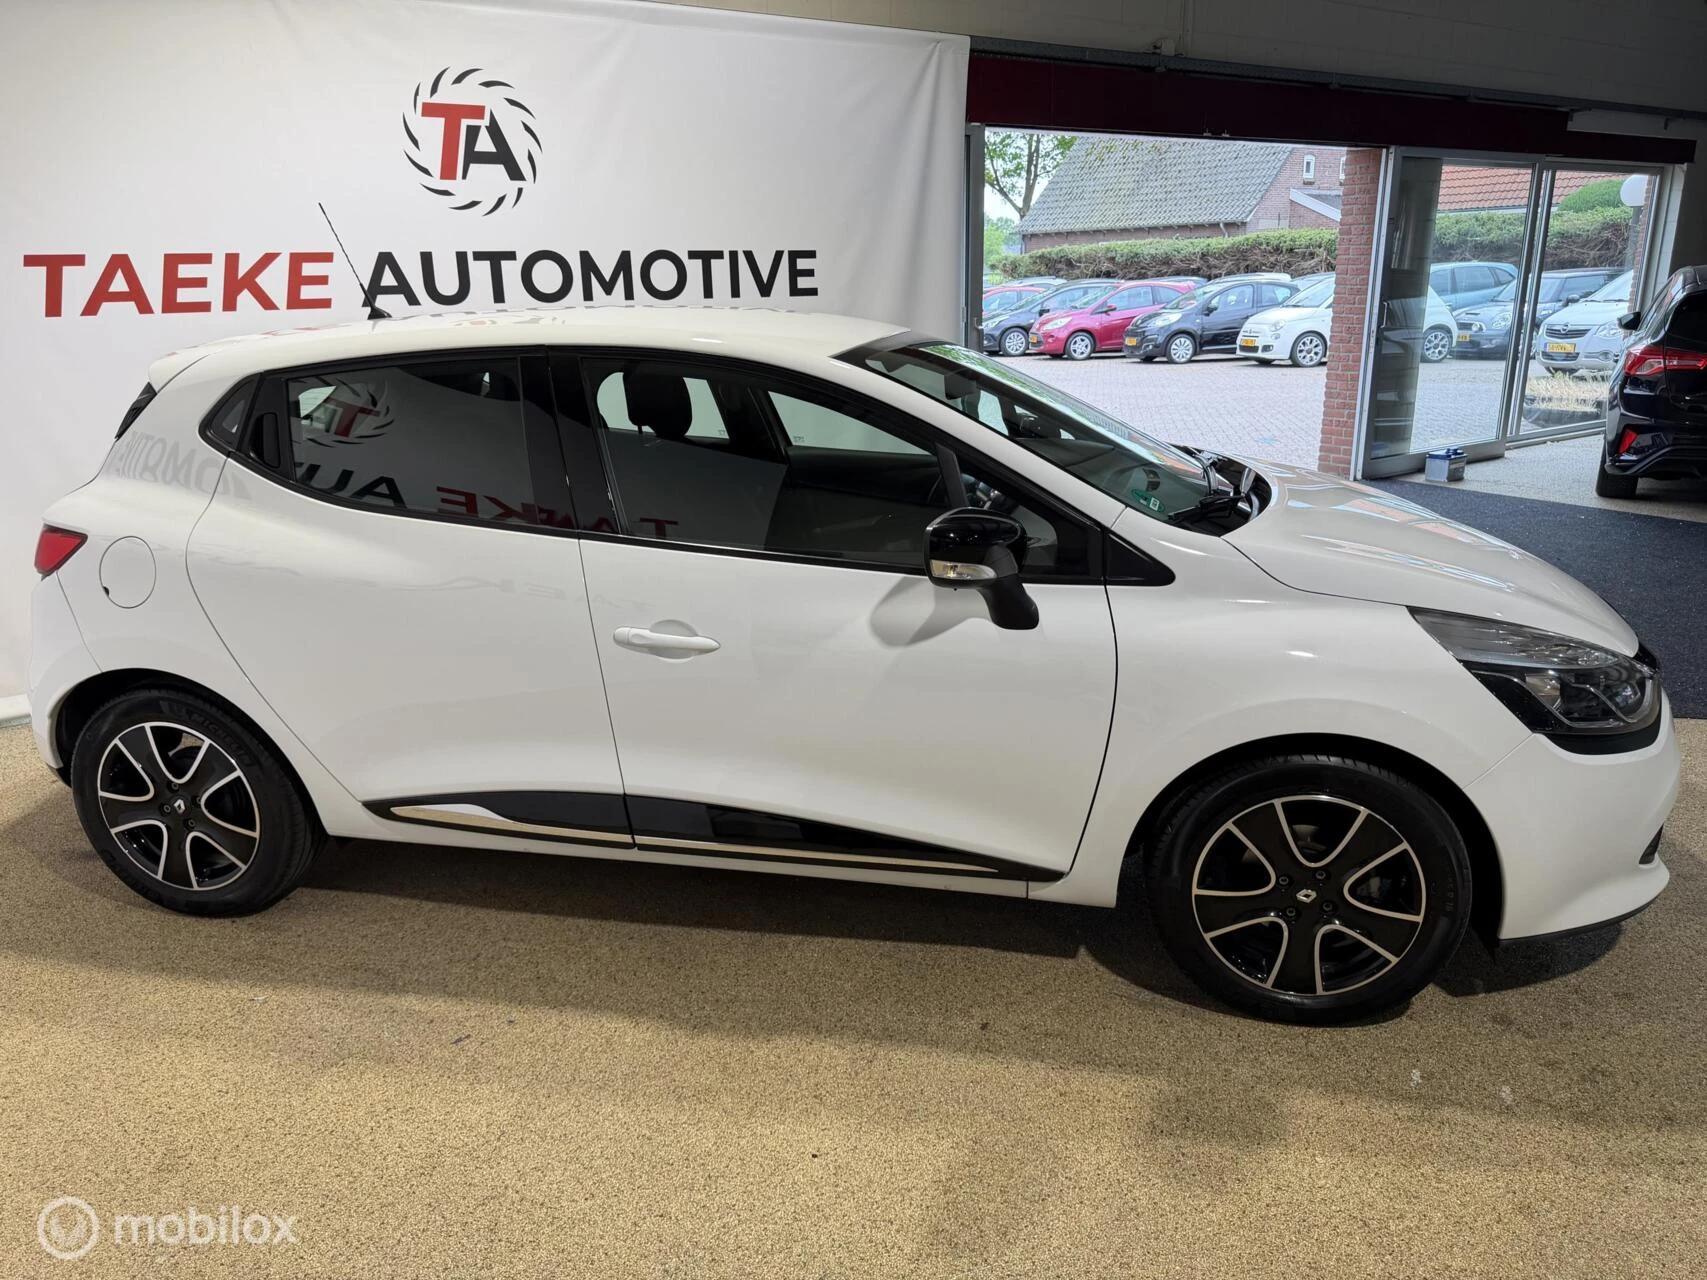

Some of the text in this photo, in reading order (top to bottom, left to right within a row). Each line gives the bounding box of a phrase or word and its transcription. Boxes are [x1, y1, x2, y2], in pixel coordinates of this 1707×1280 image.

[421, 102, 528, 182] TA
[23, 249, 819, 318] TAEKE AUTOMOTIVE
